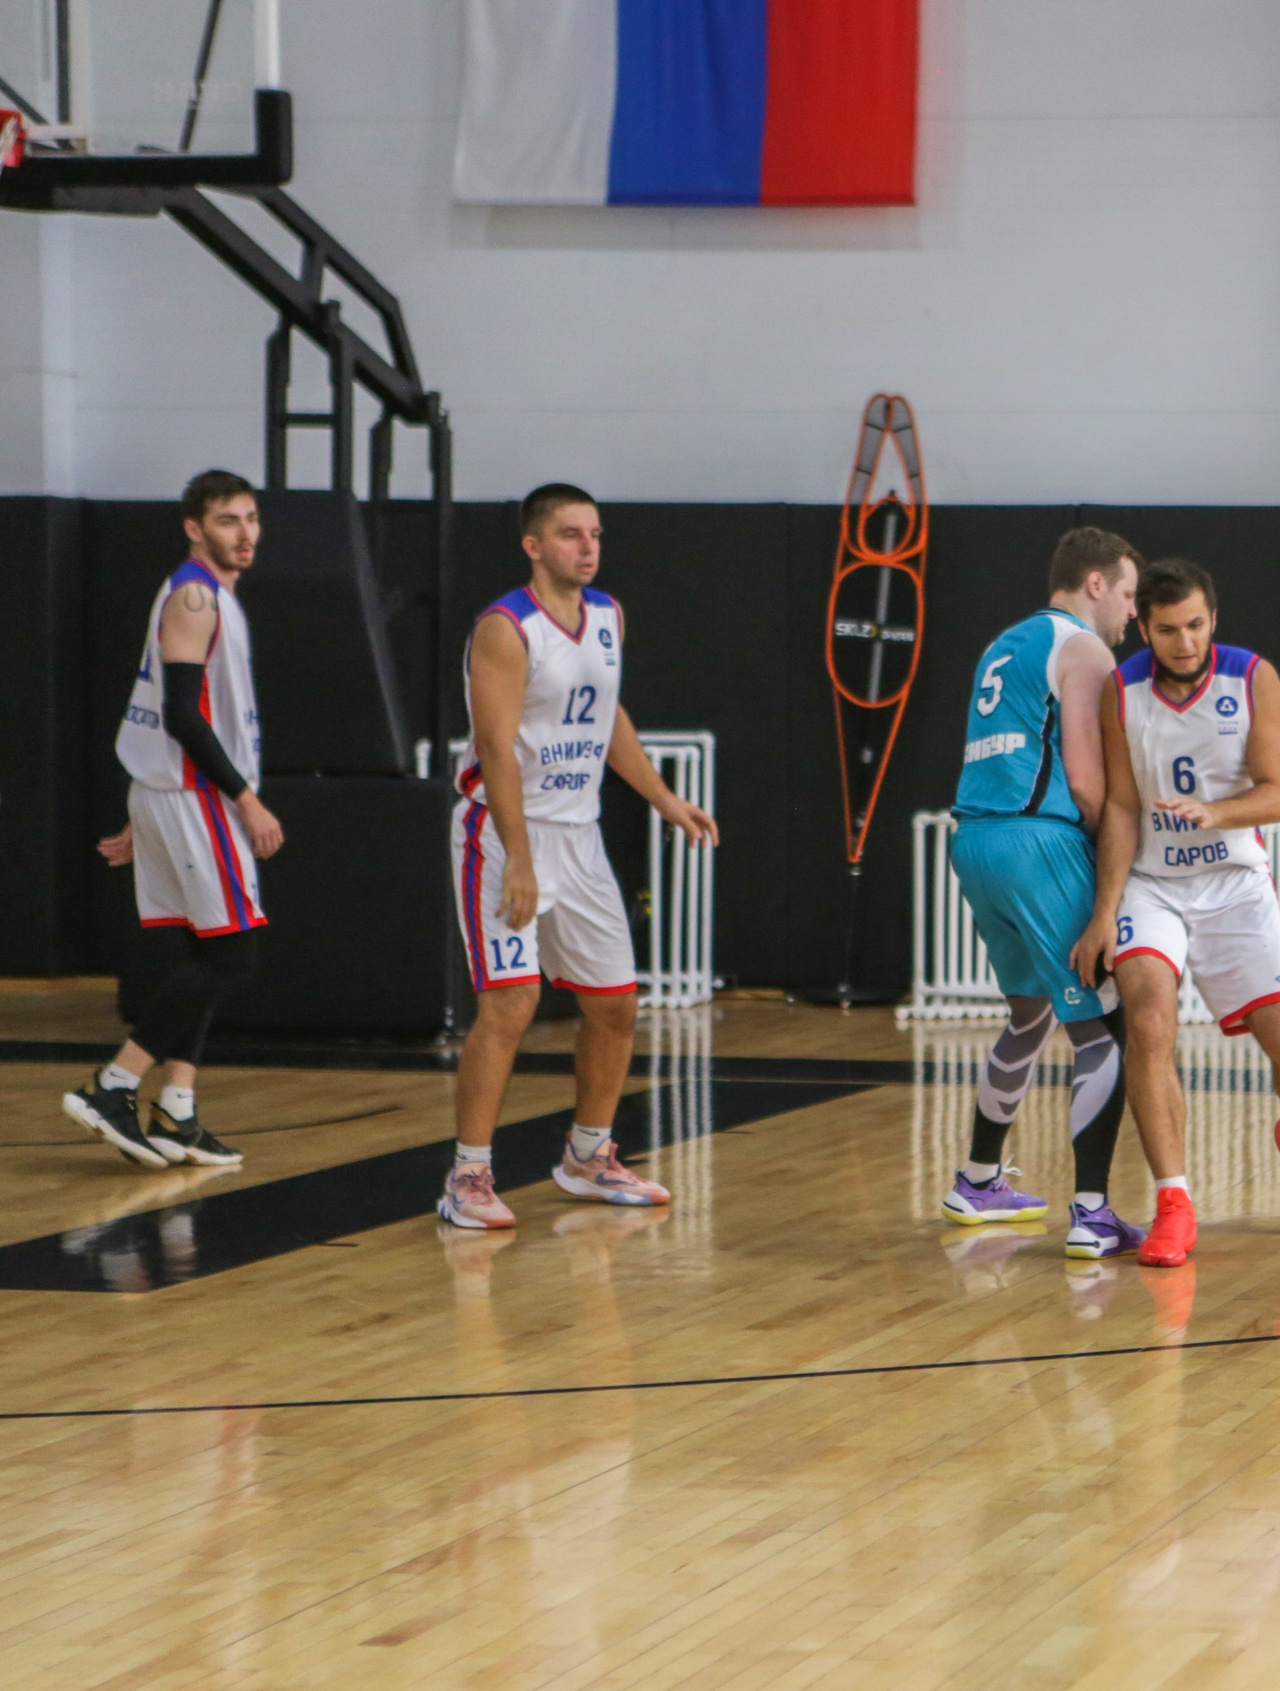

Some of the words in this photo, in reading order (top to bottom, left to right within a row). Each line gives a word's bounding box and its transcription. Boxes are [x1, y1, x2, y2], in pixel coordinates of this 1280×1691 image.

[562, 685, 597, 725] 12
[977, 654, 1014, 718] 5
[1172, 756, 1196, 795] 6
[1165, 841, 1229, 867] САРОВ
[1117, 916, 1134, 946] 6
[490, 935, 528, 972] 12
